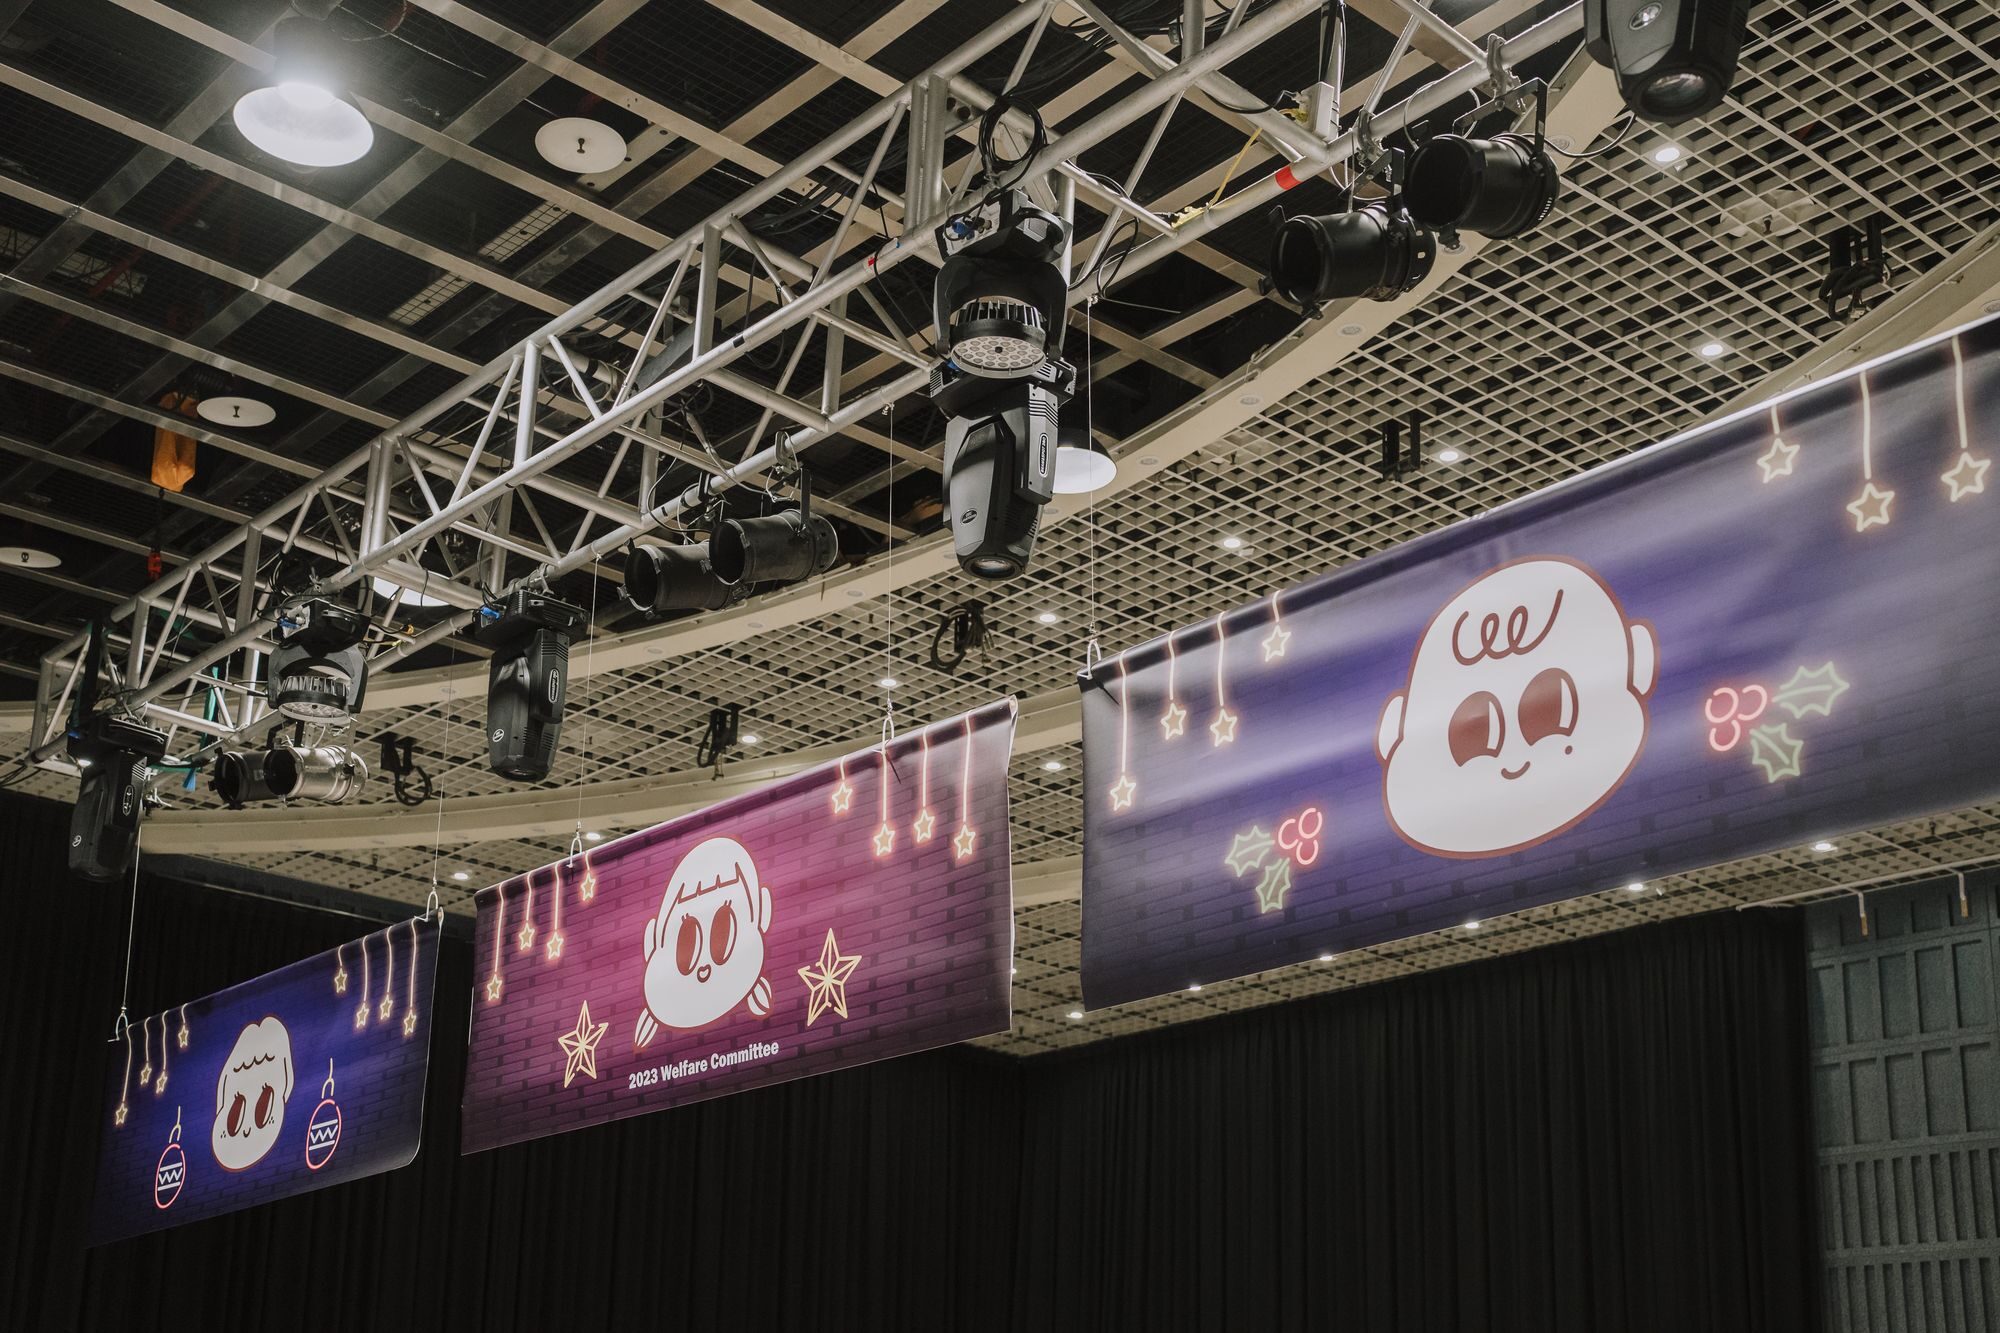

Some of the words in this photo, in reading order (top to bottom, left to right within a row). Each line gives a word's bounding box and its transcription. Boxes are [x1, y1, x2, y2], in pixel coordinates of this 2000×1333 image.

[629, 1068, 658, 1089] 2023
[660, 1059, 708, 1081] Welfare
[711, 1042, 779, 1069] Committee
